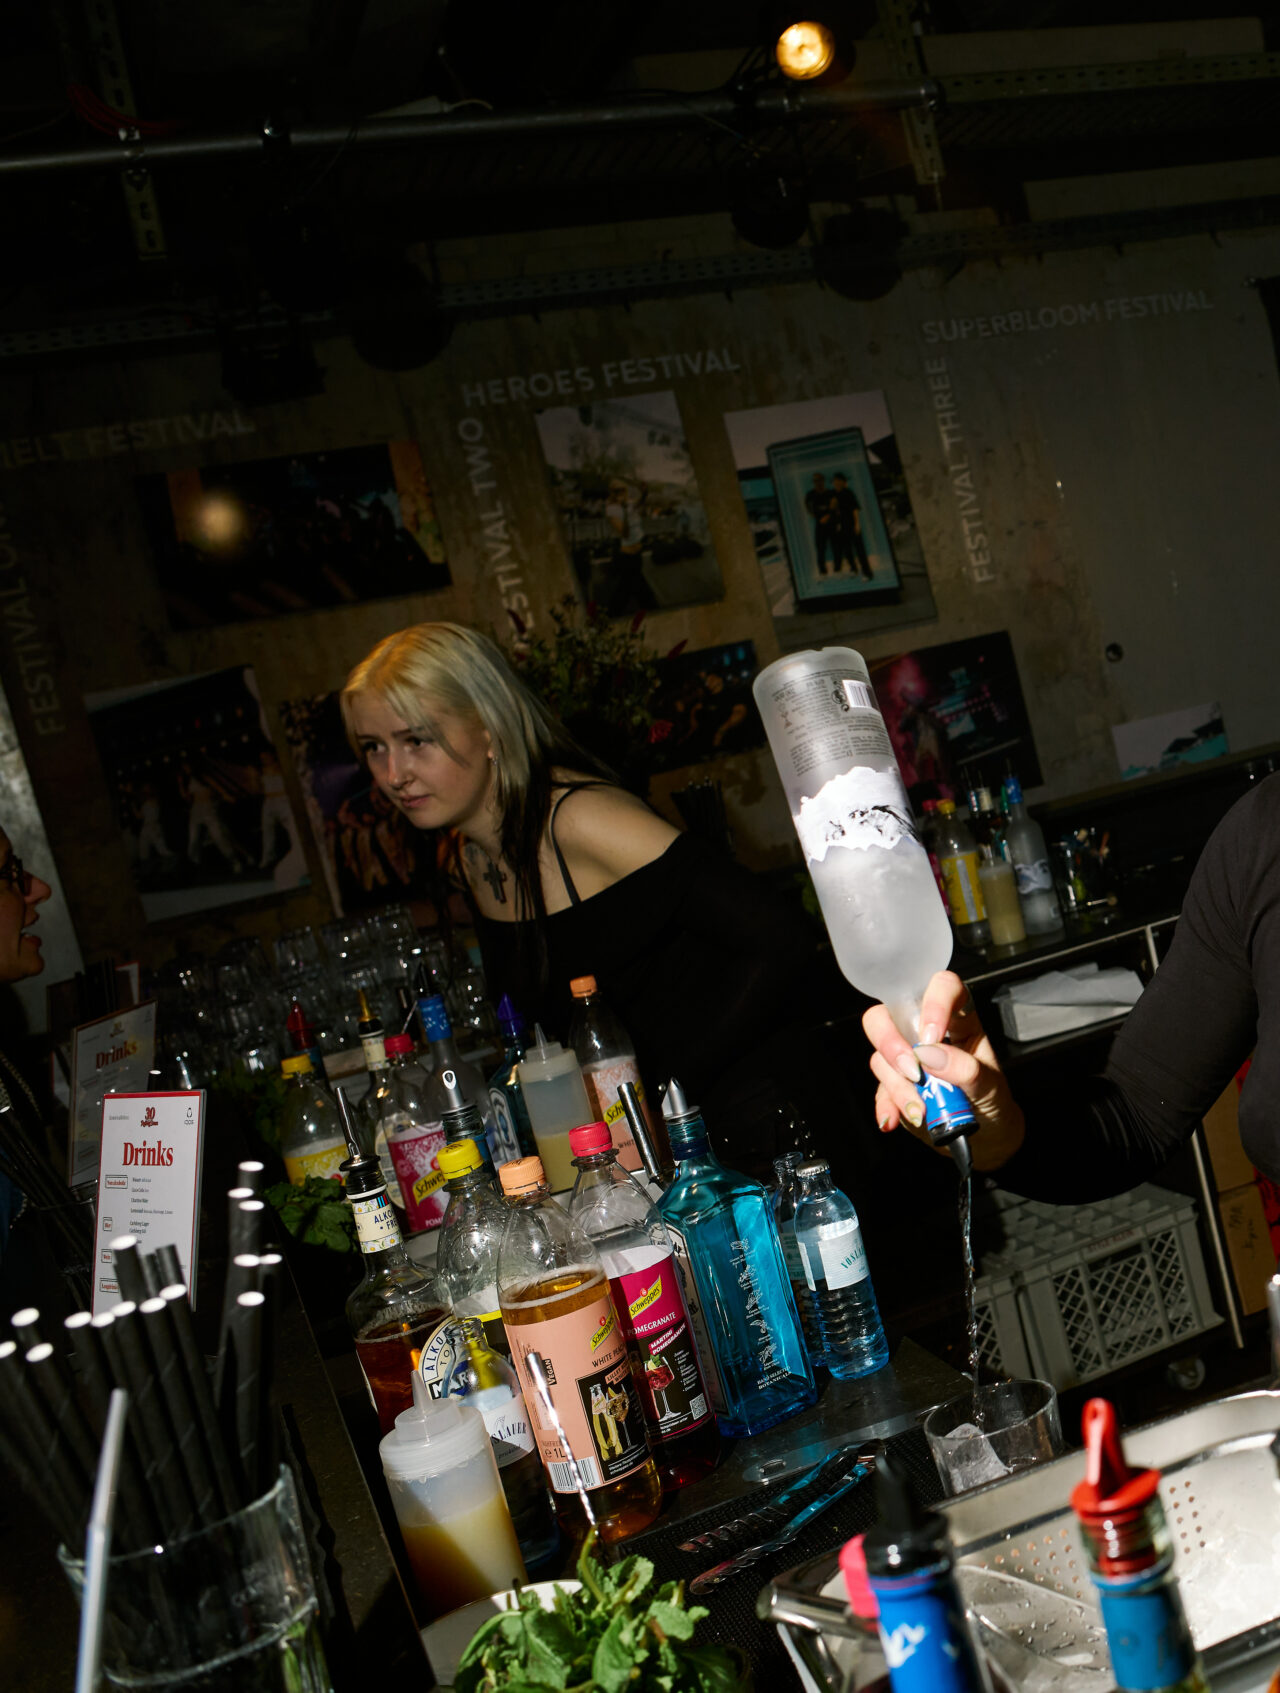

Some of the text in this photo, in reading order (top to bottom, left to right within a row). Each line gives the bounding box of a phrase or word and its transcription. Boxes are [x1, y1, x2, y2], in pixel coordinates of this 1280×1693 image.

[922, 289, 1213, 343] SUPERBLOOM FESTIVAL
[461, 347, 741, 408] HEROES FESTIVAL
[85, 407, 257, 455] FESTIVAL
[458, 416, 497, 496] TWO
[925, 355, 995, 584] FESTIVAL THREE
[4, 576, 66, 736] FESTIVAL
[96, 1041, 137, 1069] Drinks
[145, 1106, 156, 1121] 30
[122, 1140, 173, 1167] Drinks
[631, 1286, 660, 1315] Schweppes
[627, 1311, 676, 1336] POMEGRANATE
[650, 1329, 673, 1349] MARTINI
[652, 1323, 686, 1356] POMEGRANATE
[545, 1359, 555, 1385] VEGAN
[592, 1350, 613, 1368] WHITE
[758, 1371, 791, 1390] BOTANICALS
